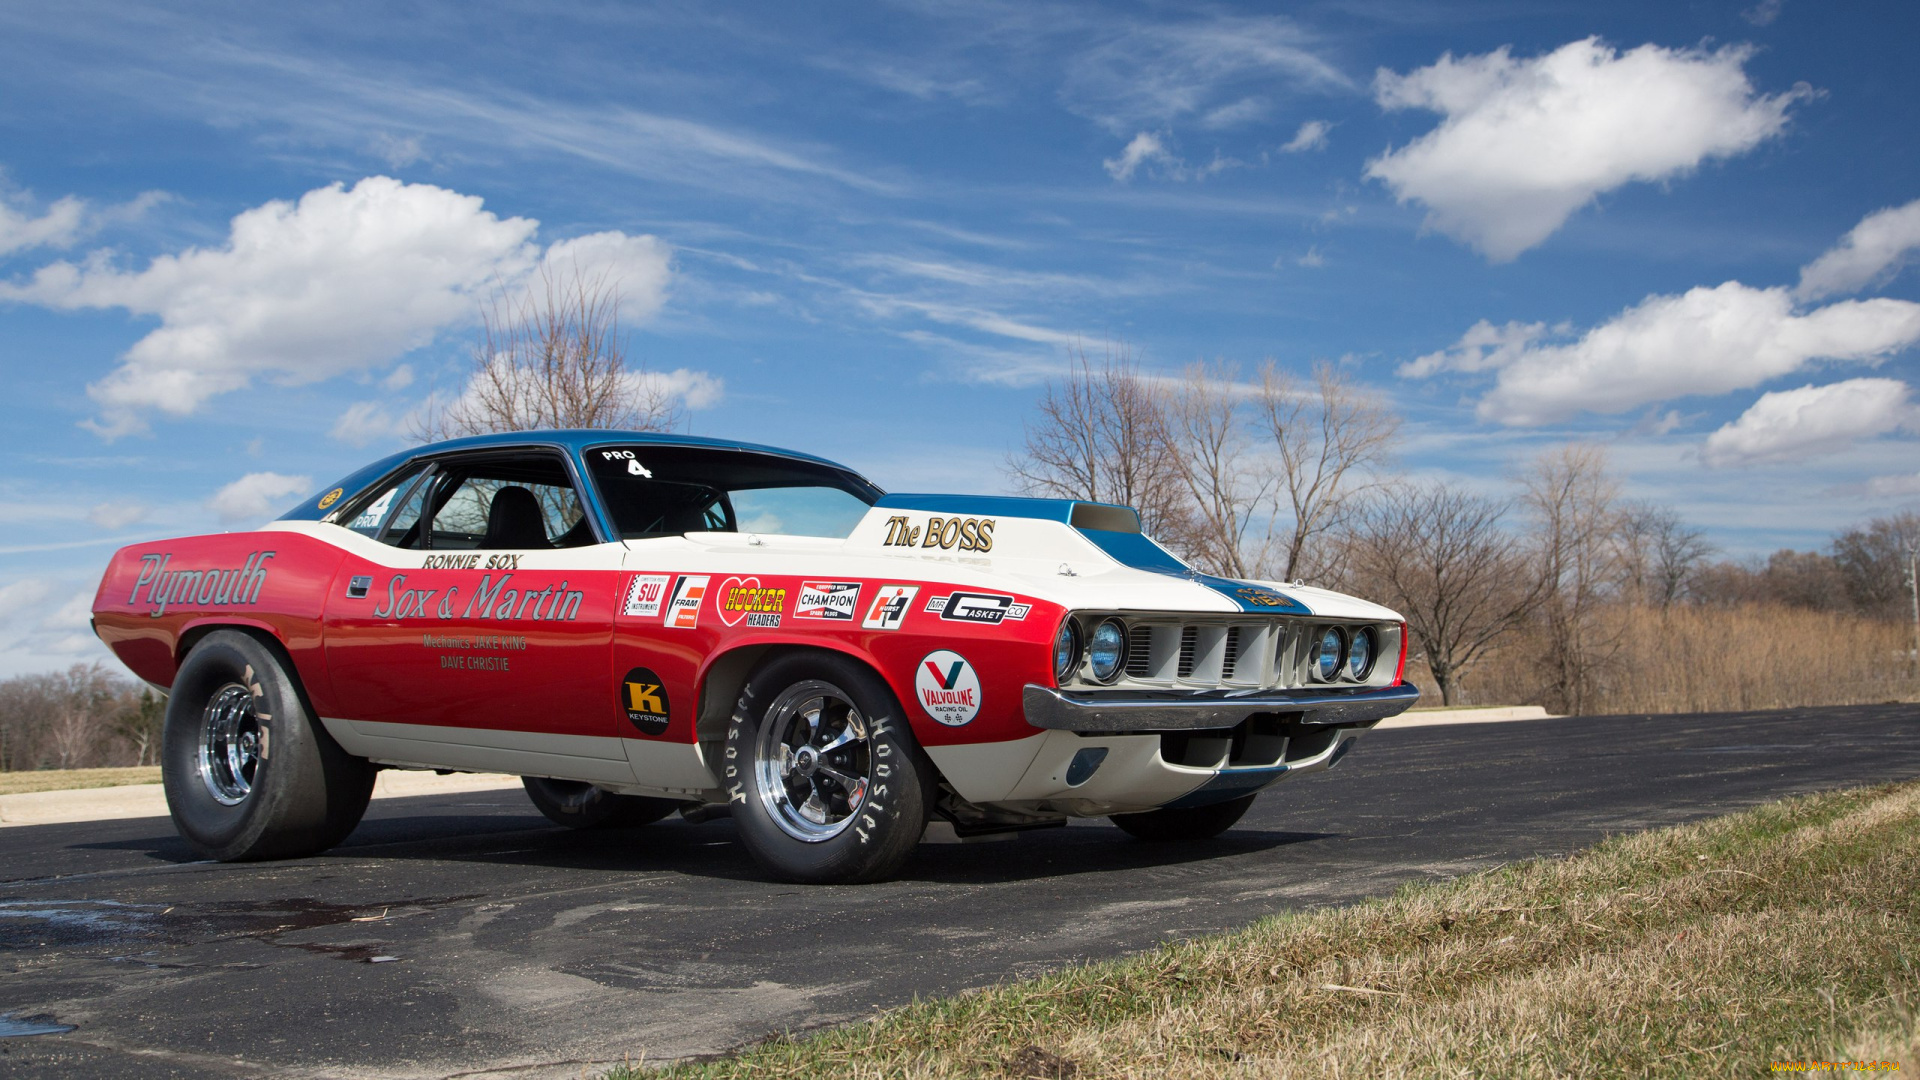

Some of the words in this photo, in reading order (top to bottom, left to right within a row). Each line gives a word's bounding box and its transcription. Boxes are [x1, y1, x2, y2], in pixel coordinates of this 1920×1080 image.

[602, 450, 635, 460] PRO
[628, 459, 653, 479] 4
[366, 488, 398, 526] 4
[355, 516, 376, 528] PRO
[883, 516, 921, 547] The
[921, 517, 996, 553] BOSS
[422, 554, 480, 570] RONNIE
[485, 554, 524, 570] SOX
[127, 551, 276, 618] Plymouth
[637, 583, 661, 602] SW
[373, 574, 438, 620] Sox
[437, 586, 459, 620] &
[461, 573, 584, 621] Martin
[675, 599, 698, 607] FRAM
[725, 587, 786, 613] HOOKER
[801, 594, 853, 606] CHAMPION
[631, 603, 658, 611] INSTRUMENTS
[747, 614, 780, 627] HEADERS
[423, 634, 470, 649] Mechanics
[473, 636, 499, 650] JAKE
[502, 636, 527, 650] KING
[440, 655, 465, 669] DAVE
[467, 656, 510, 671] CHRISTIE
[625, 682, 667, 714] K
[922, 687, 975, 707] VALVOLINE
[629, 713, 669, 724] KEYSTONE
[855, 715, 896, 844] Hoosier
